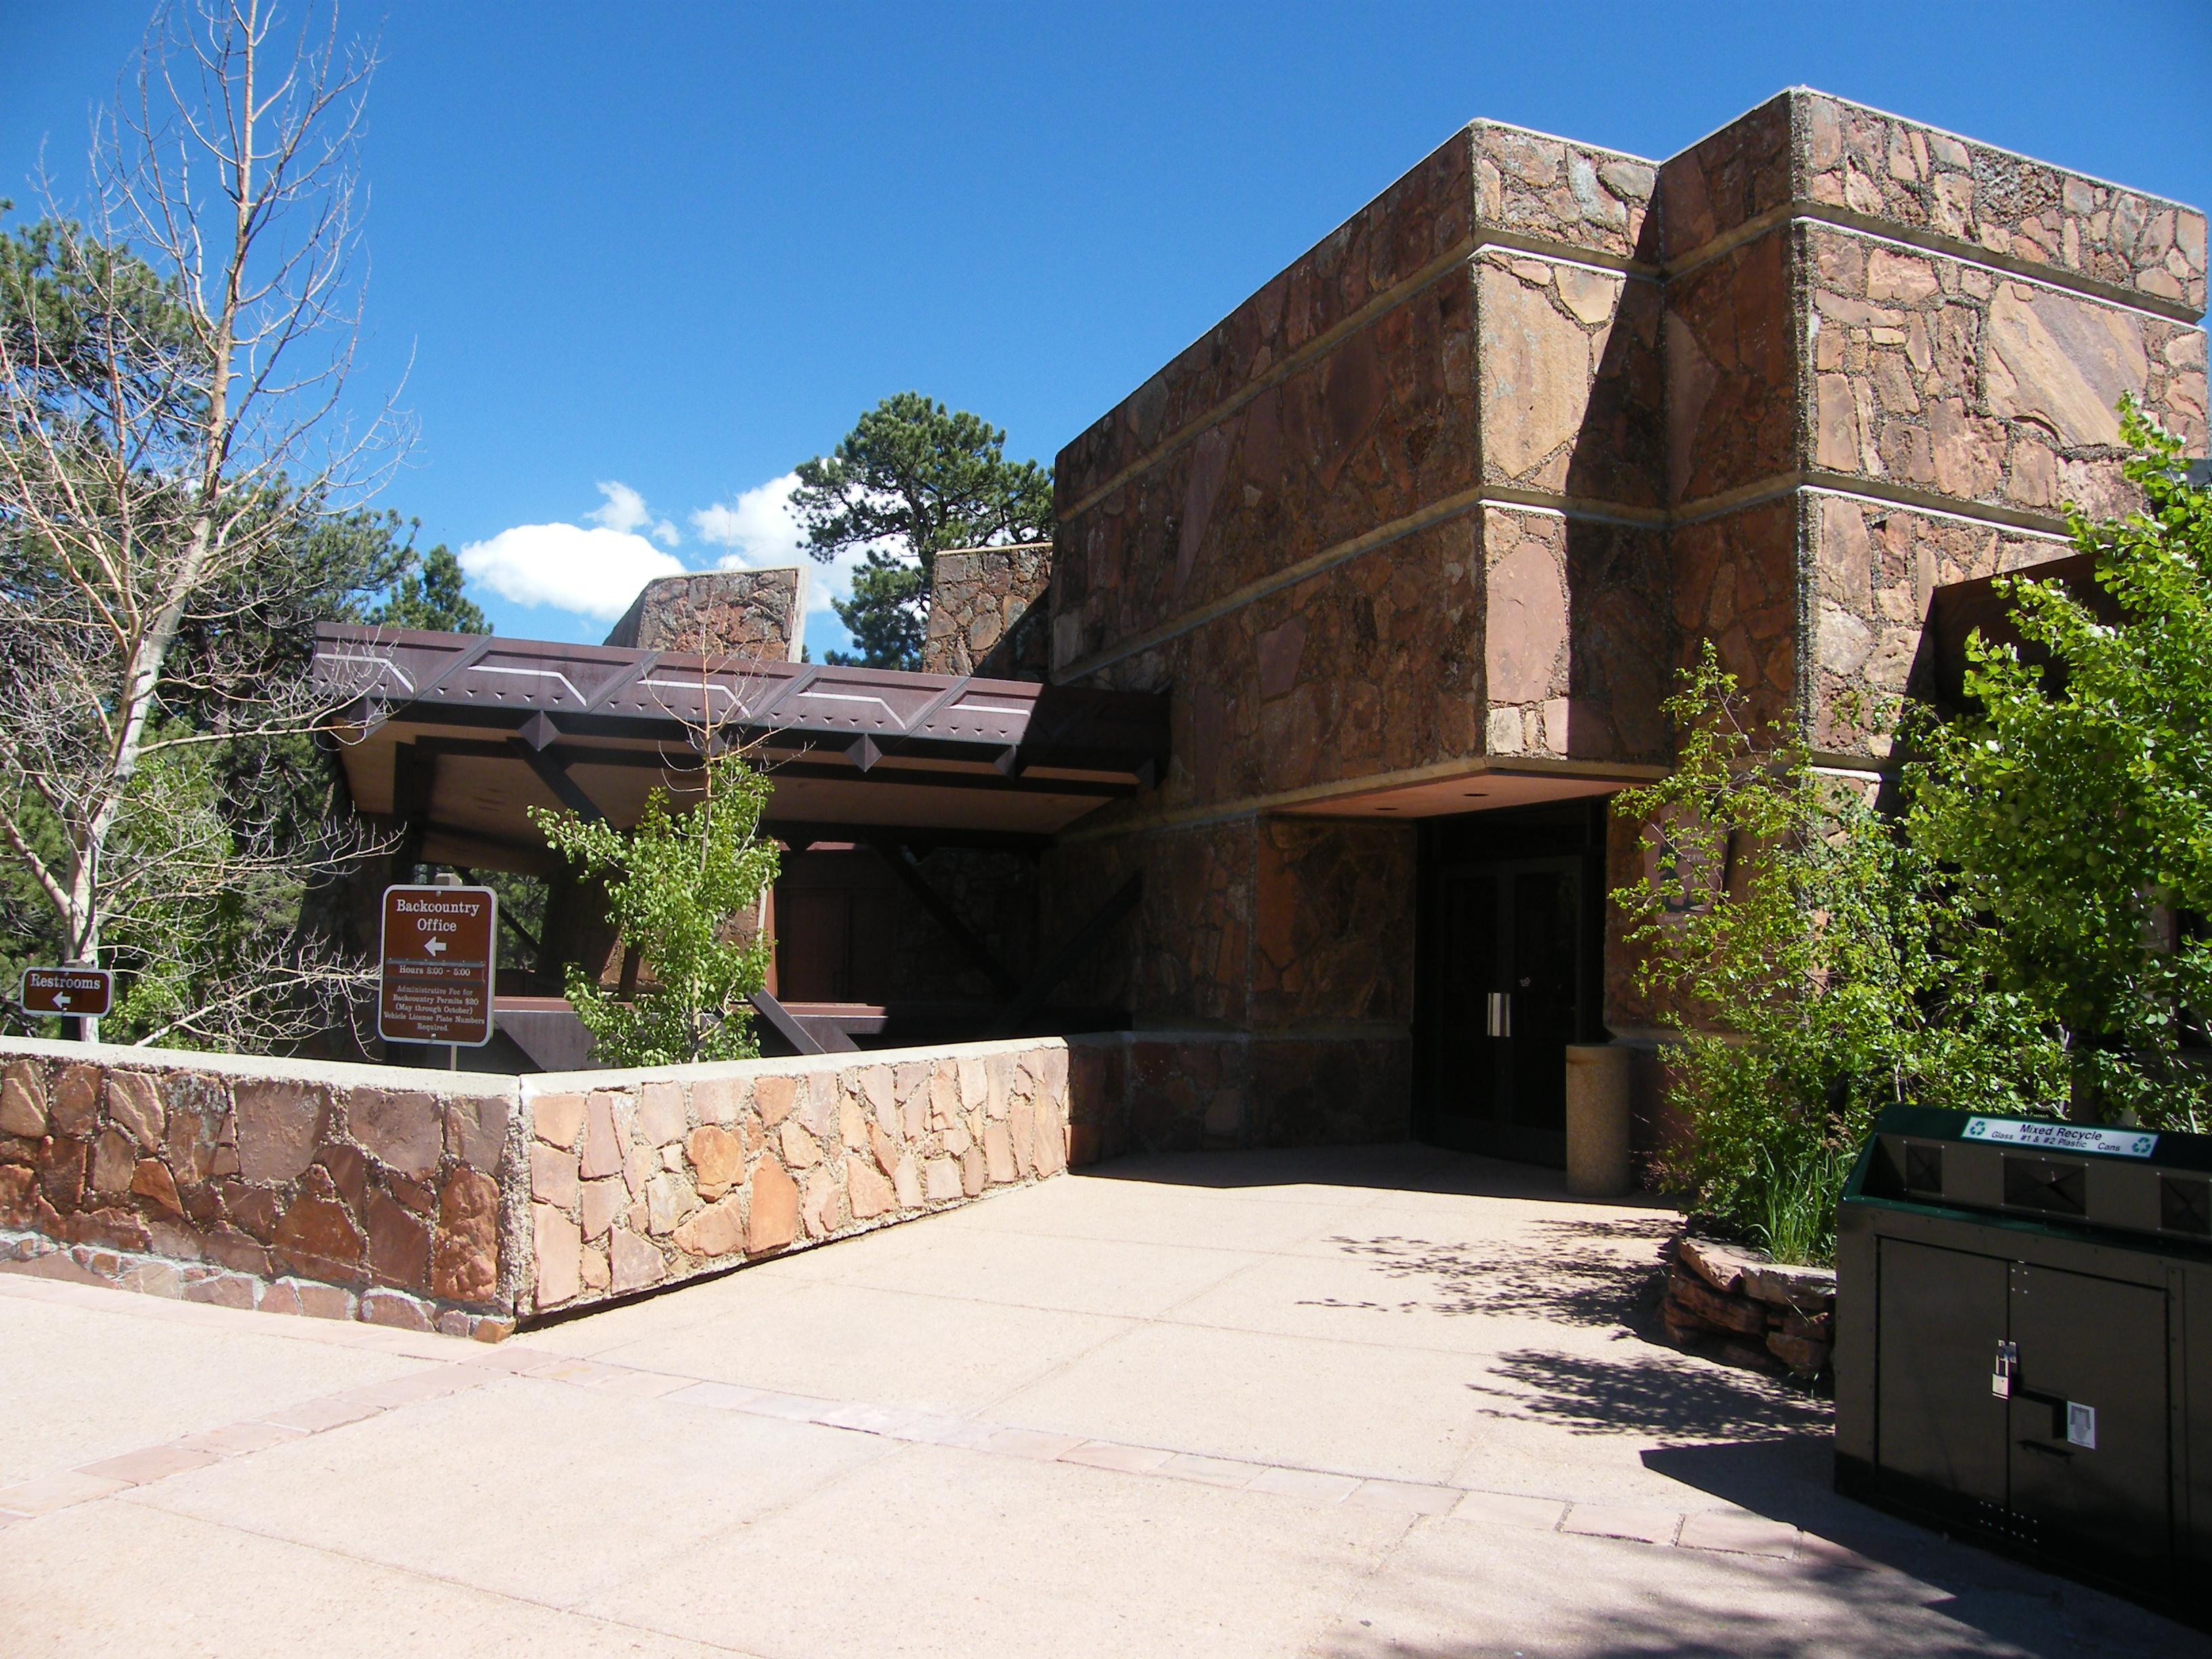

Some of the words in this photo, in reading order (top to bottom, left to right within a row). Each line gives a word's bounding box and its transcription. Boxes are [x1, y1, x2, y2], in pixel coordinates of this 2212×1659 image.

[396, 899, 480, 916] Backcountry
[417, 918, 457, 932] Office
[399, 965, 424, 975] Hours
[426, 966, 443, 975] 8:00
[453, 968, 470, 977] 5:00
[30, 973, 100, 989] Restrooms
[397, 985, 447, 996] Administrative
[463, 988, 473, 996] for
[393, 994, 434, 1005] Backcountry
[436, 997, 462, 1005] Permits
[395, 1004, 412, 1012] (May
[415, 1005, 442, 1014] through
[444, 1006, 473, 1015] October)
[384, 1012, 407, 1020] Vehicle
[409, 1012, 434, 1021] License
[436, 1014, 453, 1023] Plate
[455, 1016, 485, 1025] Numbers
[417, 1023, 449, 1032] Required.
[2020, 1124, 2053, 1136] Mixed
[2056, 1128, 2102, 1141] Recycle
[1991, 1131, 2013, 1140] Glass
[2057, 1138, 2087, 1148] Plastic
[2097, 1142, 2121, 1152] Cans
